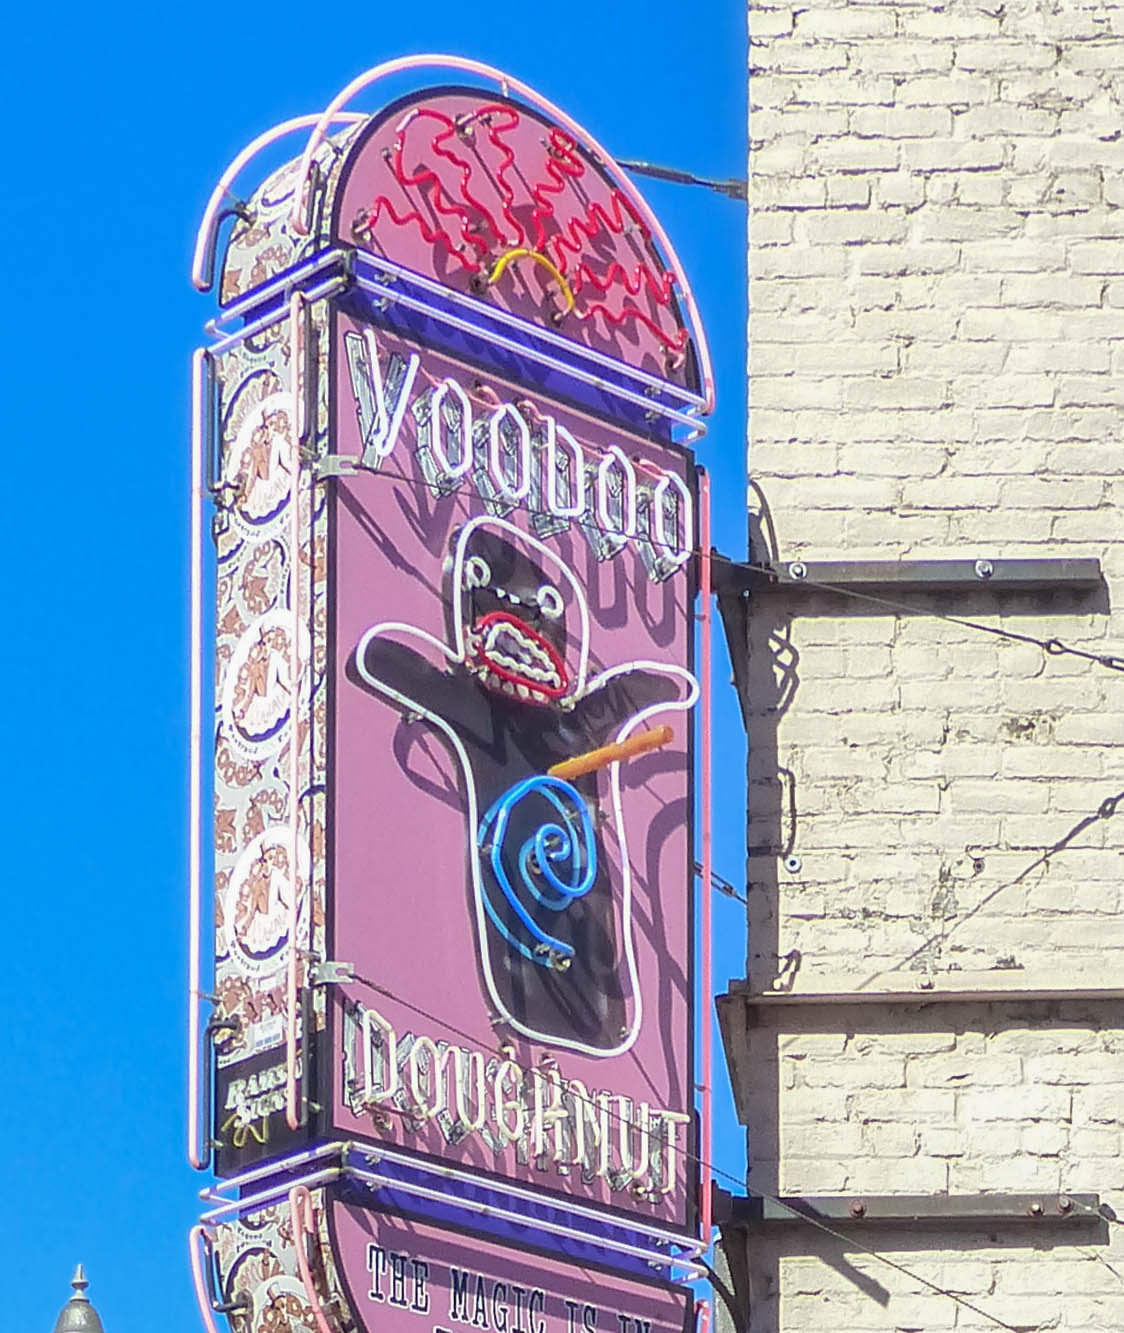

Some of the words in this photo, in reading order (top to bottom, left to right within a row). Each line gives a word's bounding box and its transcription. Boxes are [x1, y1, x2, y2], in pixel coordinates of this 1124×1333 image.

[345, 328, 694, 584] VOODOO
[342, 999, 691, 1199] DOUGHNUT
[367, 1244, 429, 1314] THE
